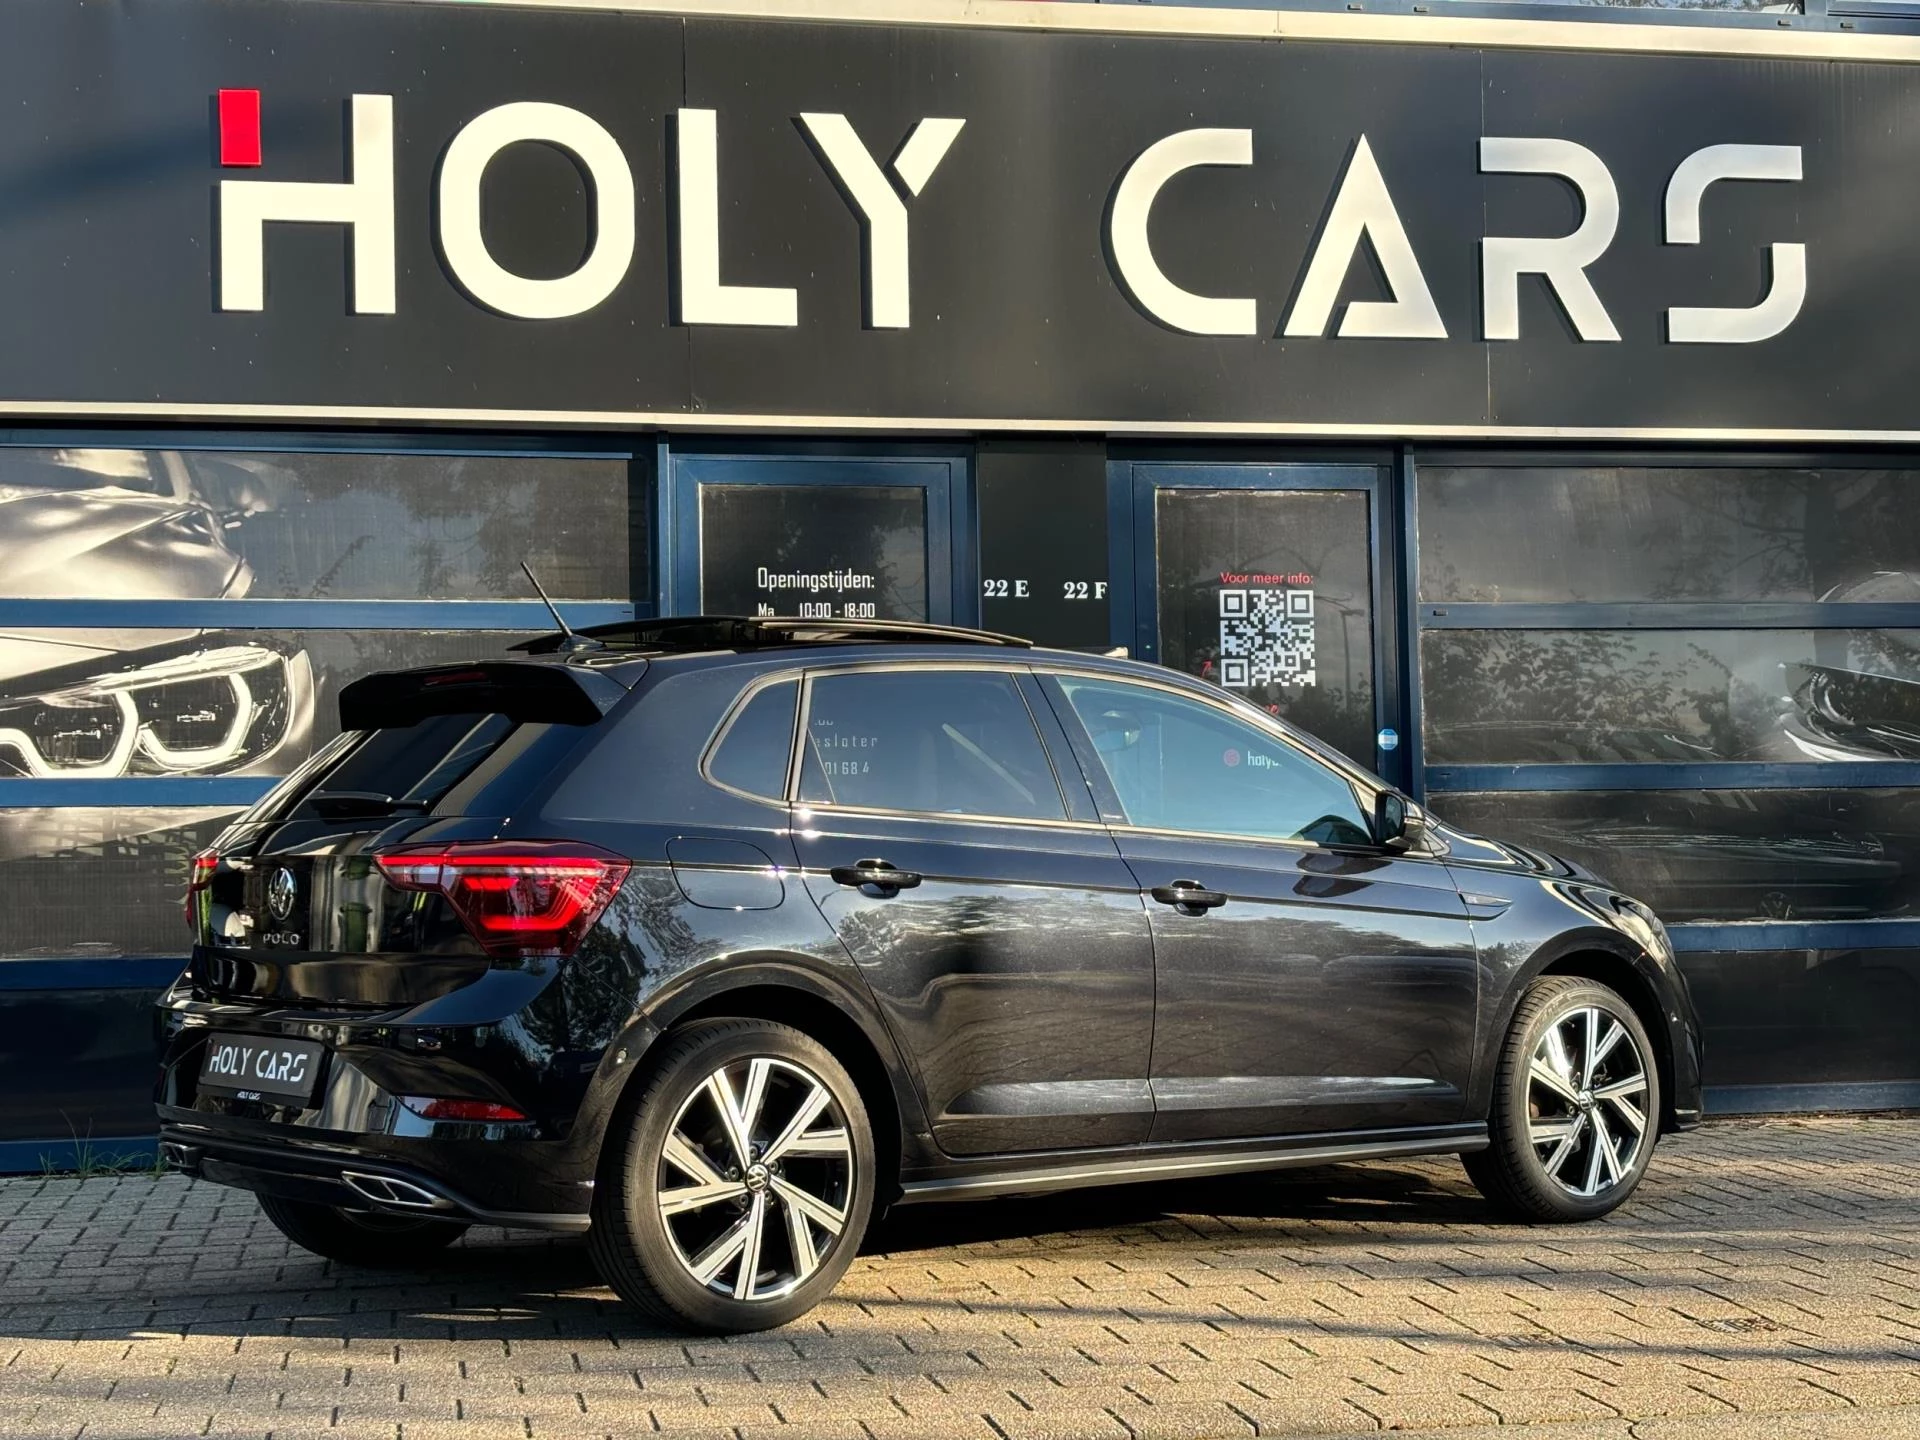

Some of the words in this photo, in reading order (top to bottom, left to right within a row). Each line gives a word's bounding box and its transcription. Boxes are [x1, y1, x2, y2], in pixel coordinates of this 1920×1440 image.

[217, 88, 967, 329] HOLY
[1111, 127, 1807, 344] CARS
[757, 567, 875, 592] Openingstijden:
[1219, 571, 1249, 584] Voor
[1252, 573, 1283, 584] meer
[1287, 571, 1314, 584] info:
[983, 579, 1009, 597] 22
[1014, 579, 1030, 597] E
[1063, 581, 1089, 599] 22
[1094, 581, 1108, 599] F
[757, 602, 775, 617] Ma
[799, 602, 832, 618] 10:00
[844, 602, 876, 618] 18:00
[263, 932, 300, 945] POLO
[208, 1044, 254, 1076] HOLY
[255, 1050, 308, 1082] CARS
